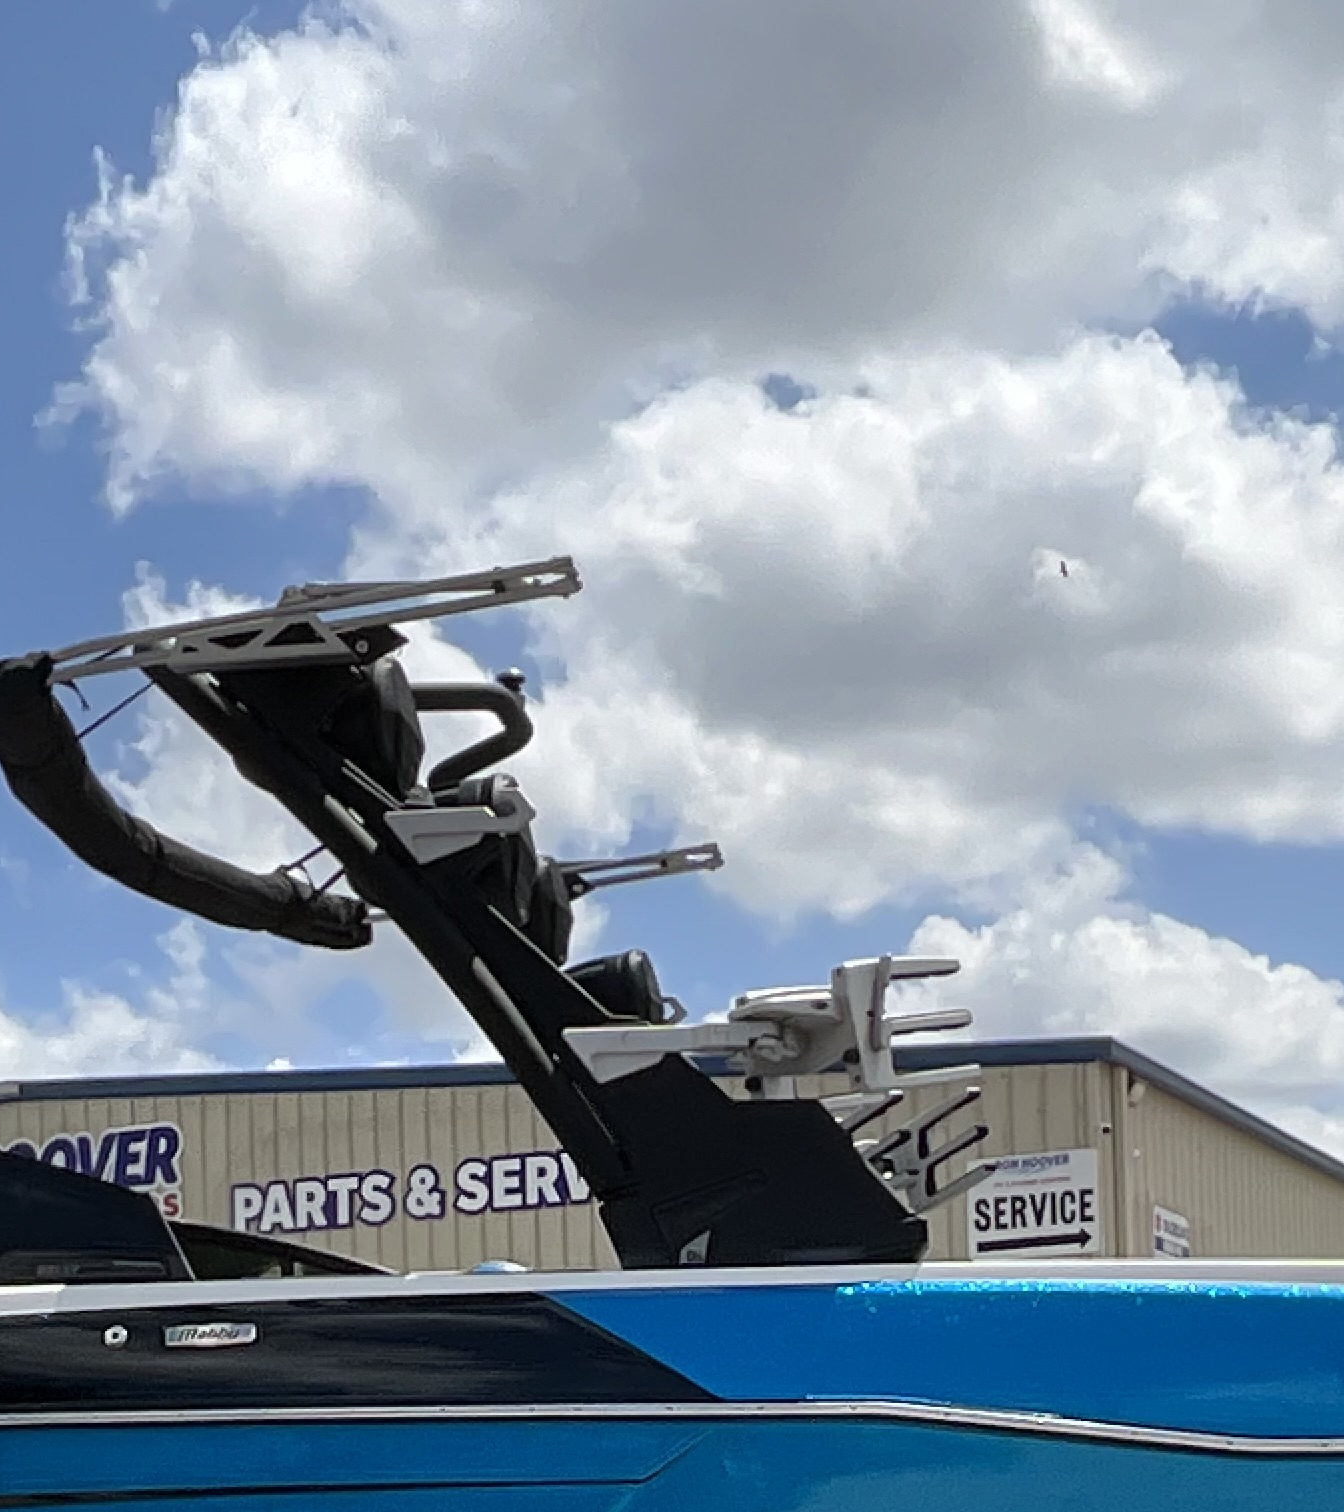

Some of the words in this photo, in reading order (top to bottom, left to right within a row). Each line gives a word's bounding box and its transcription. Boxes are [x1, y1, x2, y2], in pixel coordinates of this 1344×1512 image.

[232, 1172, 394, 1233] PARTS
[406, 1165, 444, 1219] &
[974, 1187, 1096, 1232] SERVICE
